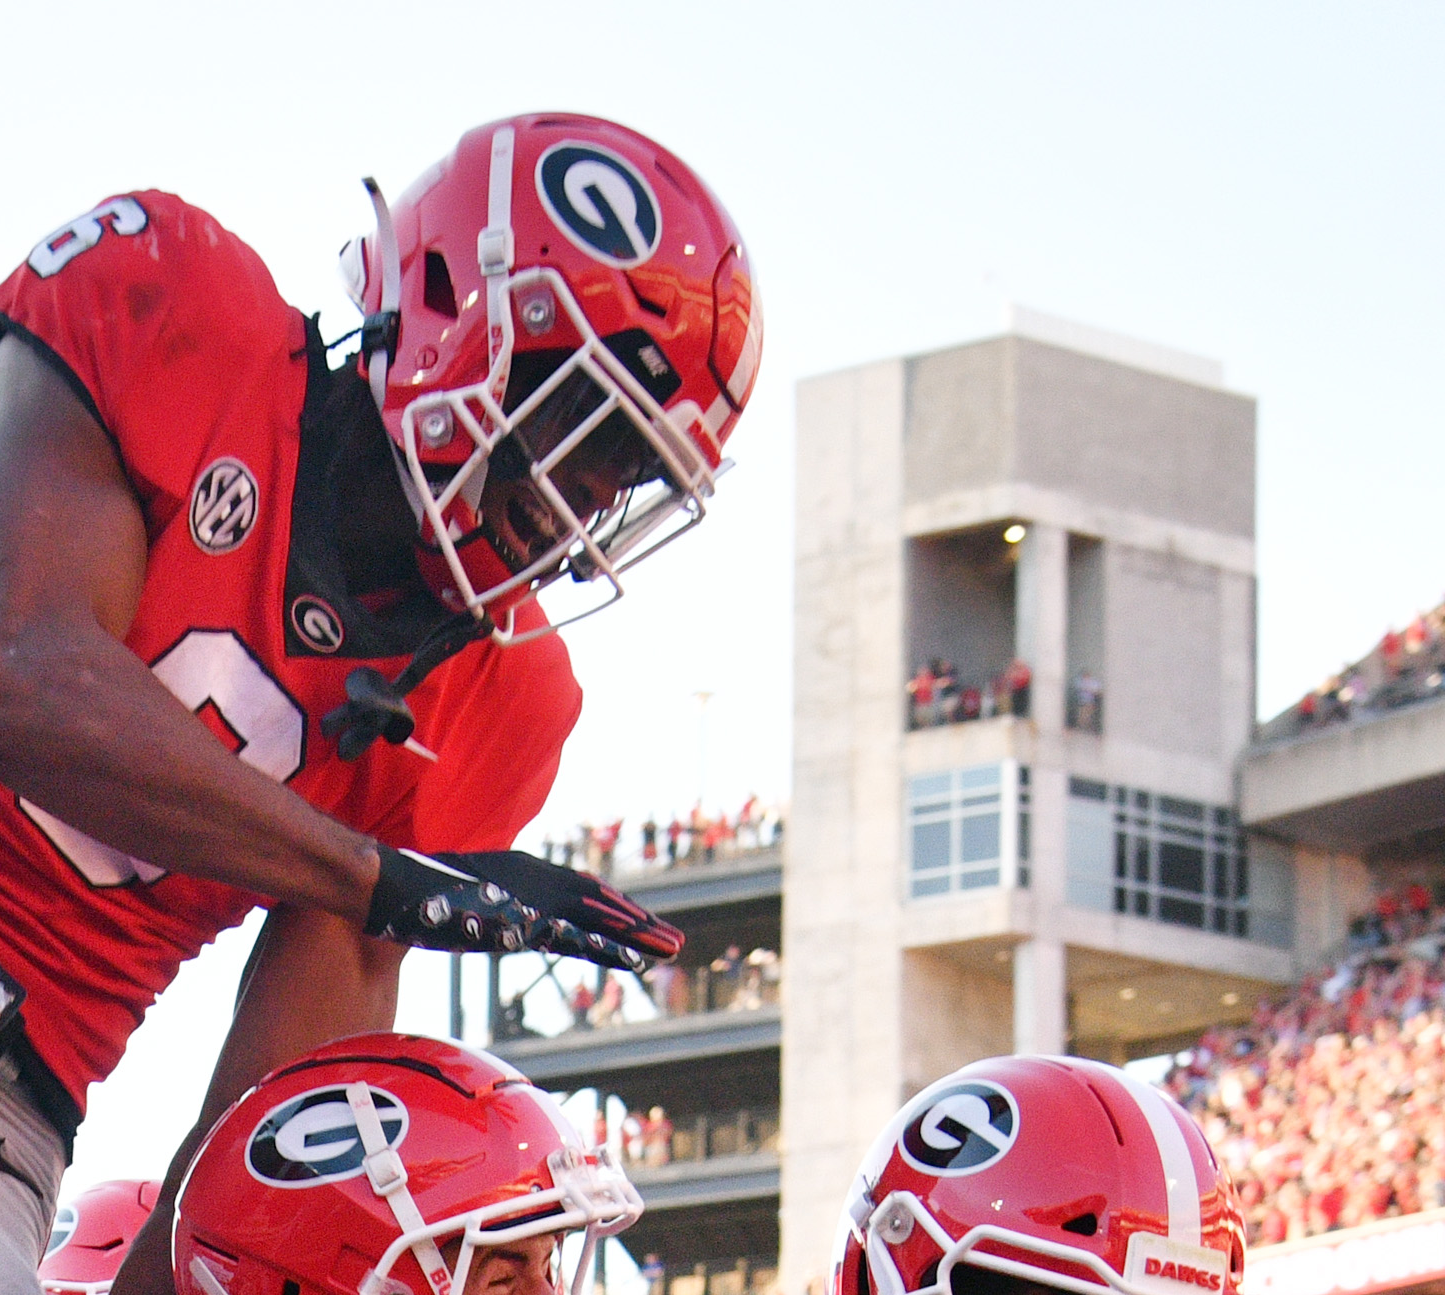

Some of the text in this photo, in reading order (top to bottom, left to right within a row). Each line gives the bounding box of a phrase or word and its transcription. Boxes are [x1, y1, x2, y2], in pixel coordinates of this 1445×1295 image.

[27, 196, 149, 280] 6
[191, 466, 257, 549] SEC
[900, 1081, 1018, 1174] G
[1144, 1257, 1222, 1292] DAWGS
